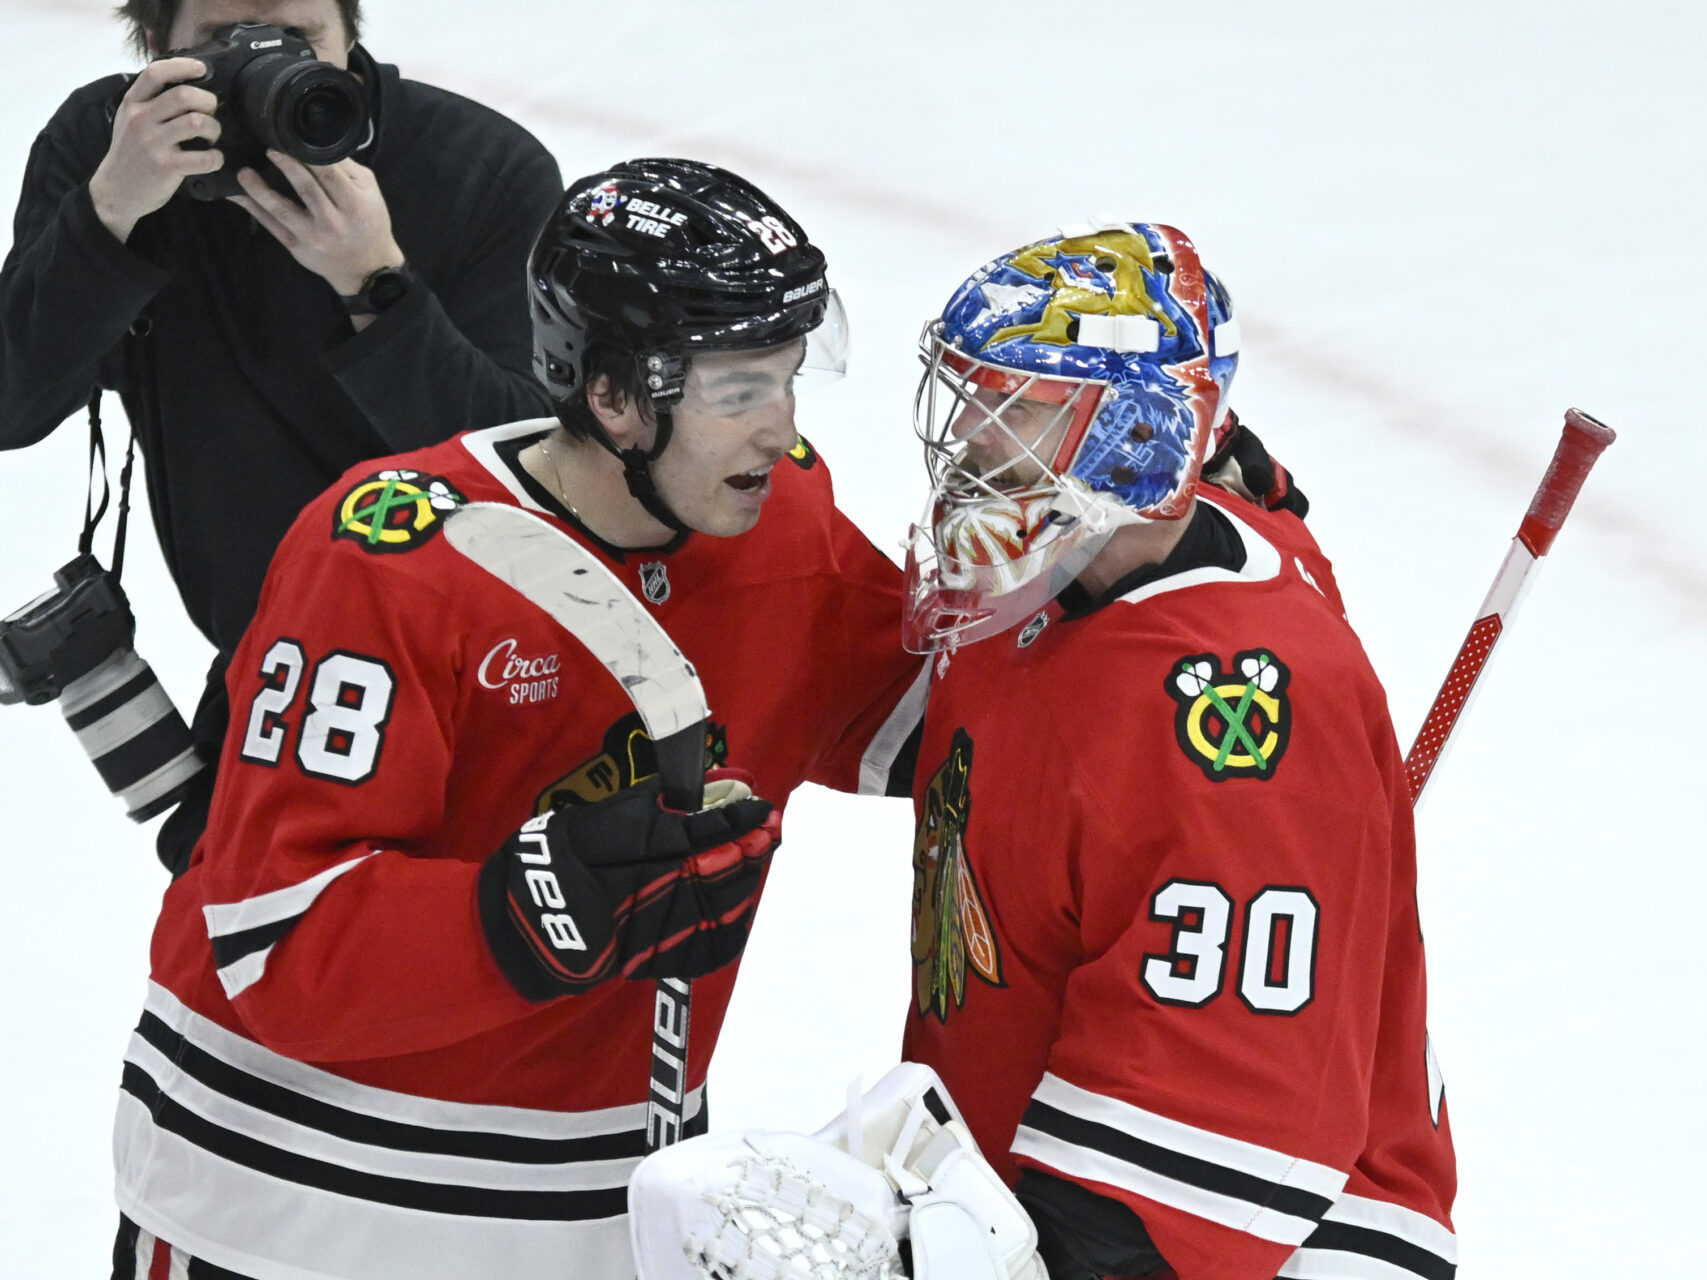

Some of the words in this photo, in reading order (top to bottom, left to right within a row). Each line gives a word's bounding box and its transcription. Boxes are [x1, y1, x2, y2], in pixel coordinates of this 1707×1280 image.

[250, 39, 283, 50] Canon
[625, 197, 689, 227] BELLE
[625, 213, 672, 239] TIRE
[782, 278, 824, 304] BAUER
[651, 386, 681, 399] BAUER
[477, 638, 562, 689] Circa
[509, 676, 559, 704] SPORTS
[240, 637, 398, 787] 28
[1139, 876, 1321, 1017] 30
